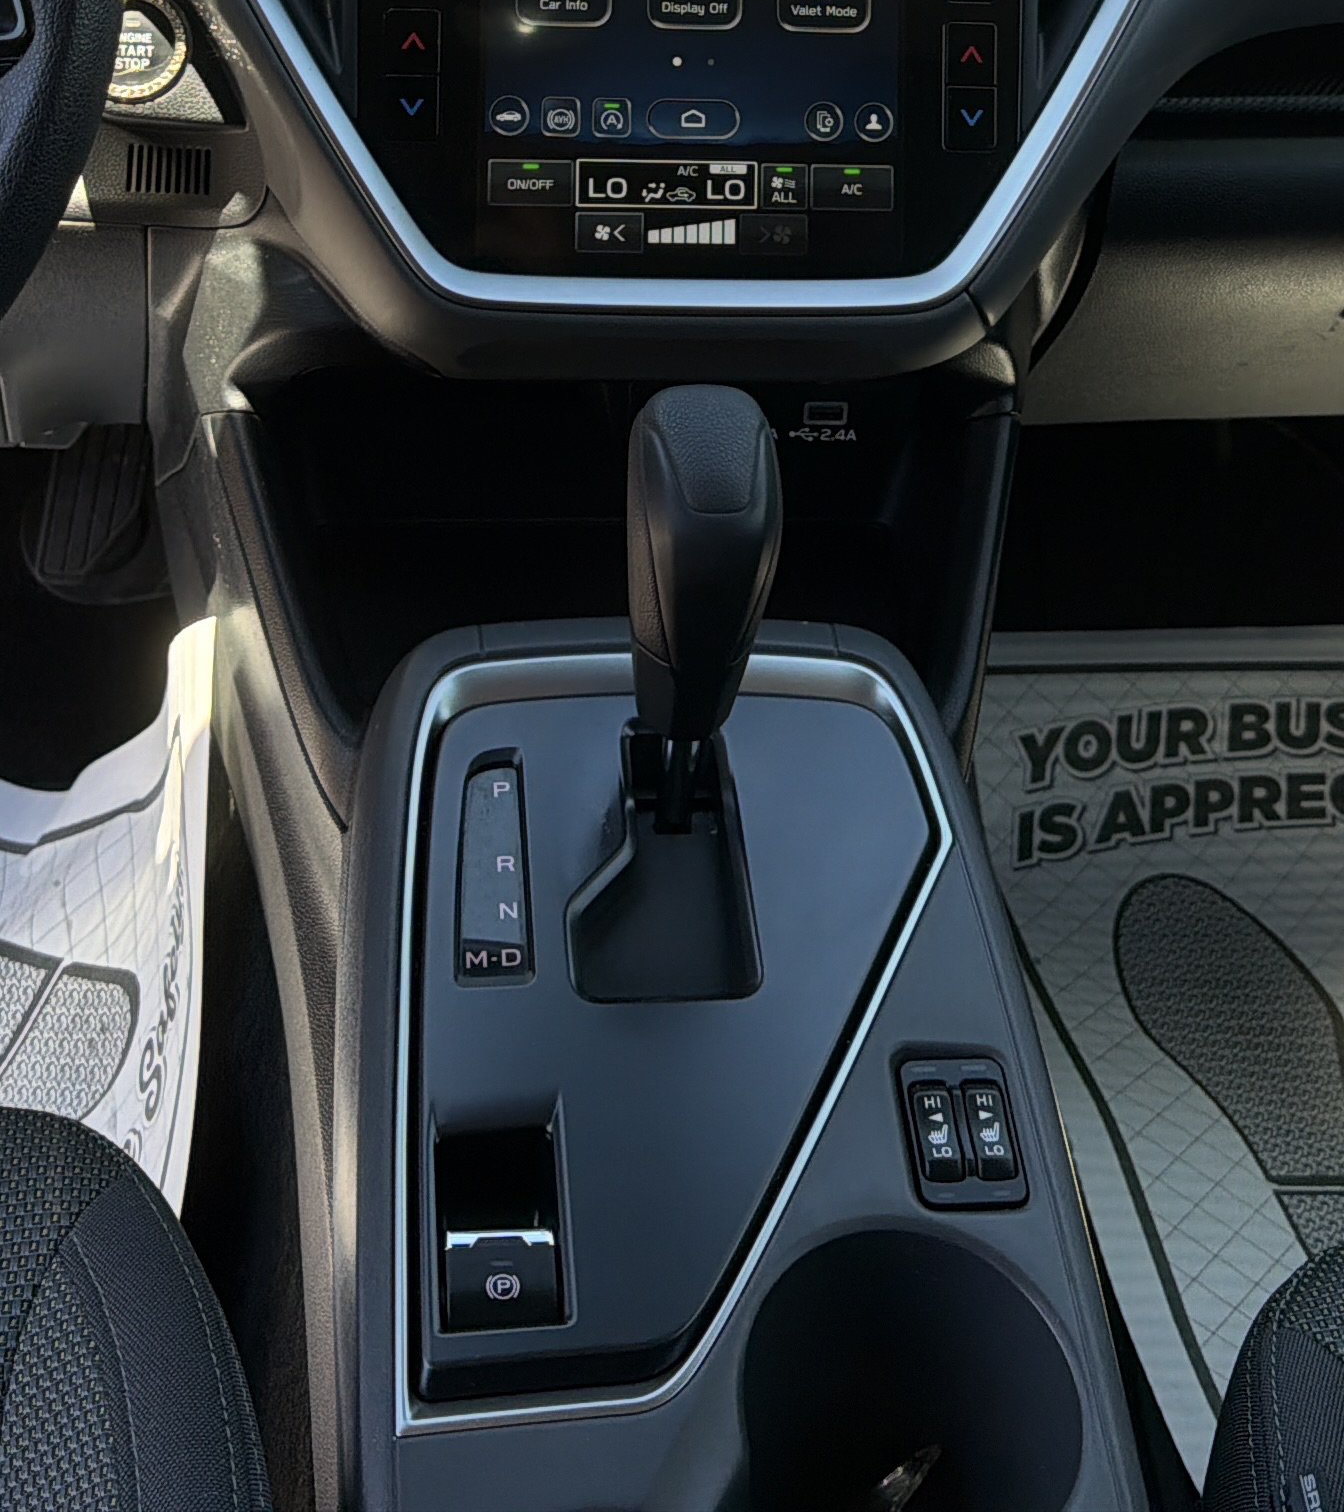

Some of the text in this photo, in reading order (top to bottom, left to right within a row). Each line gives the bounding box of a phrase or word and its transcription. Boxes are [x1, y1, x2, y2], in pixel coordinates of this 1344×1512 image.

[539, 0, 588, 11] Car Info
[662, 2, 729, 15] Display Off
[790, 5, 857, 17] Valet Mode
[119, 32, 153, 43] NGINE
[117, 44, 155, 58] TART
[115, 57, 150, 71] STOP
[677, 165, 699, 177] A/C
[719, 165, 737, 174] ALL
[507, 179, 554, 190] ON/OFF
[588, 177, 628, 199] LO
[707, 179, 745, 200] LO
[841, 184, 863, 195] A/C
[771, 192, 797, 203] ALL
[820, 428, 856, 441] 2.4A
[1018, 704, 1210, 784] YOUR
[493, 782, 511, 798] P
[1015, 801, 1081, 863] IS
[496, 855, 515, 872] R
[499, 902, 518, 920] N
[924, 1096, 941, 1108] HI
[976, 1094, 993, 1106] HI
[932, 1147, 952, 1157] LO
[985, 1145, 1004, 1155] LO
[1303, 1473, 1323, 1512] SR
